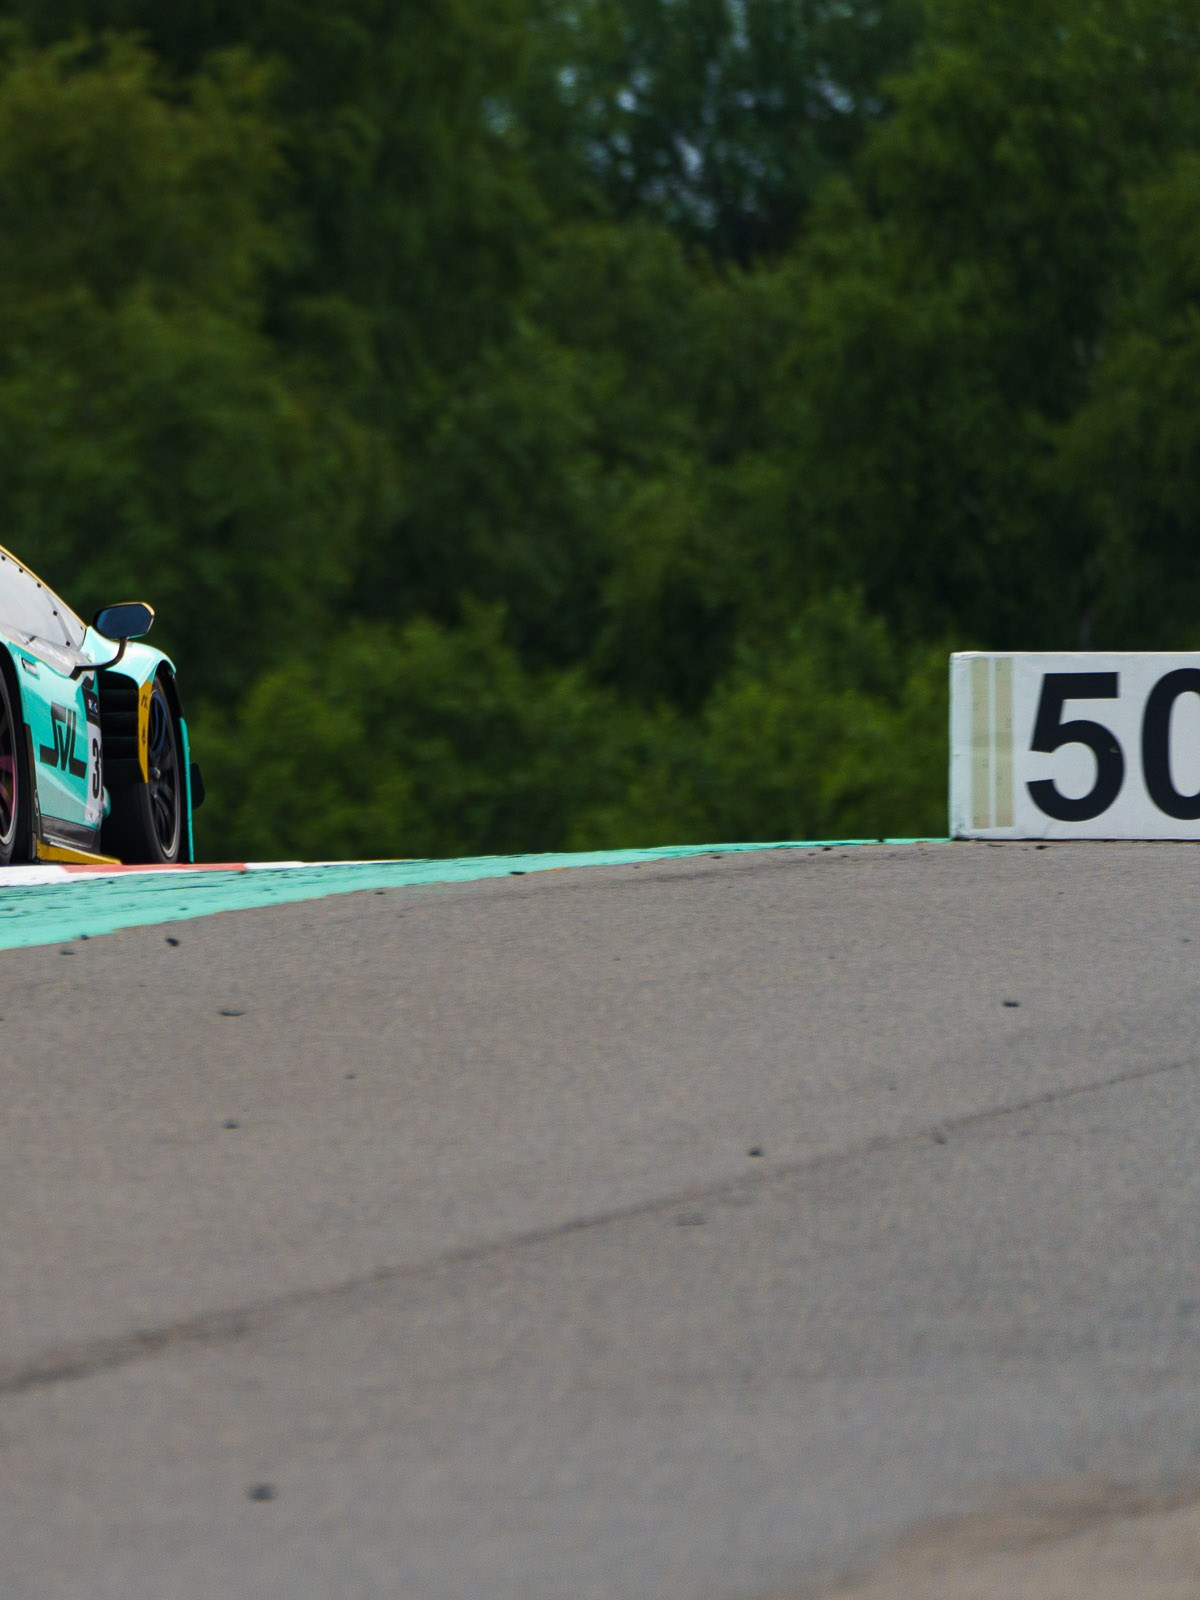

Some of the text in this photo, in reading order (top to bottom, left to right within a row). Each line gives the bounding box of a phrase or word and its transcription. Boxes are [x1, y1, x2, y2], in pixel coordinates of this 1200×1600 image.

[39, 701, 87, 780] SVL
[92, 737, 103, 800] 3
[1026, 668, 1200, 822] 50
